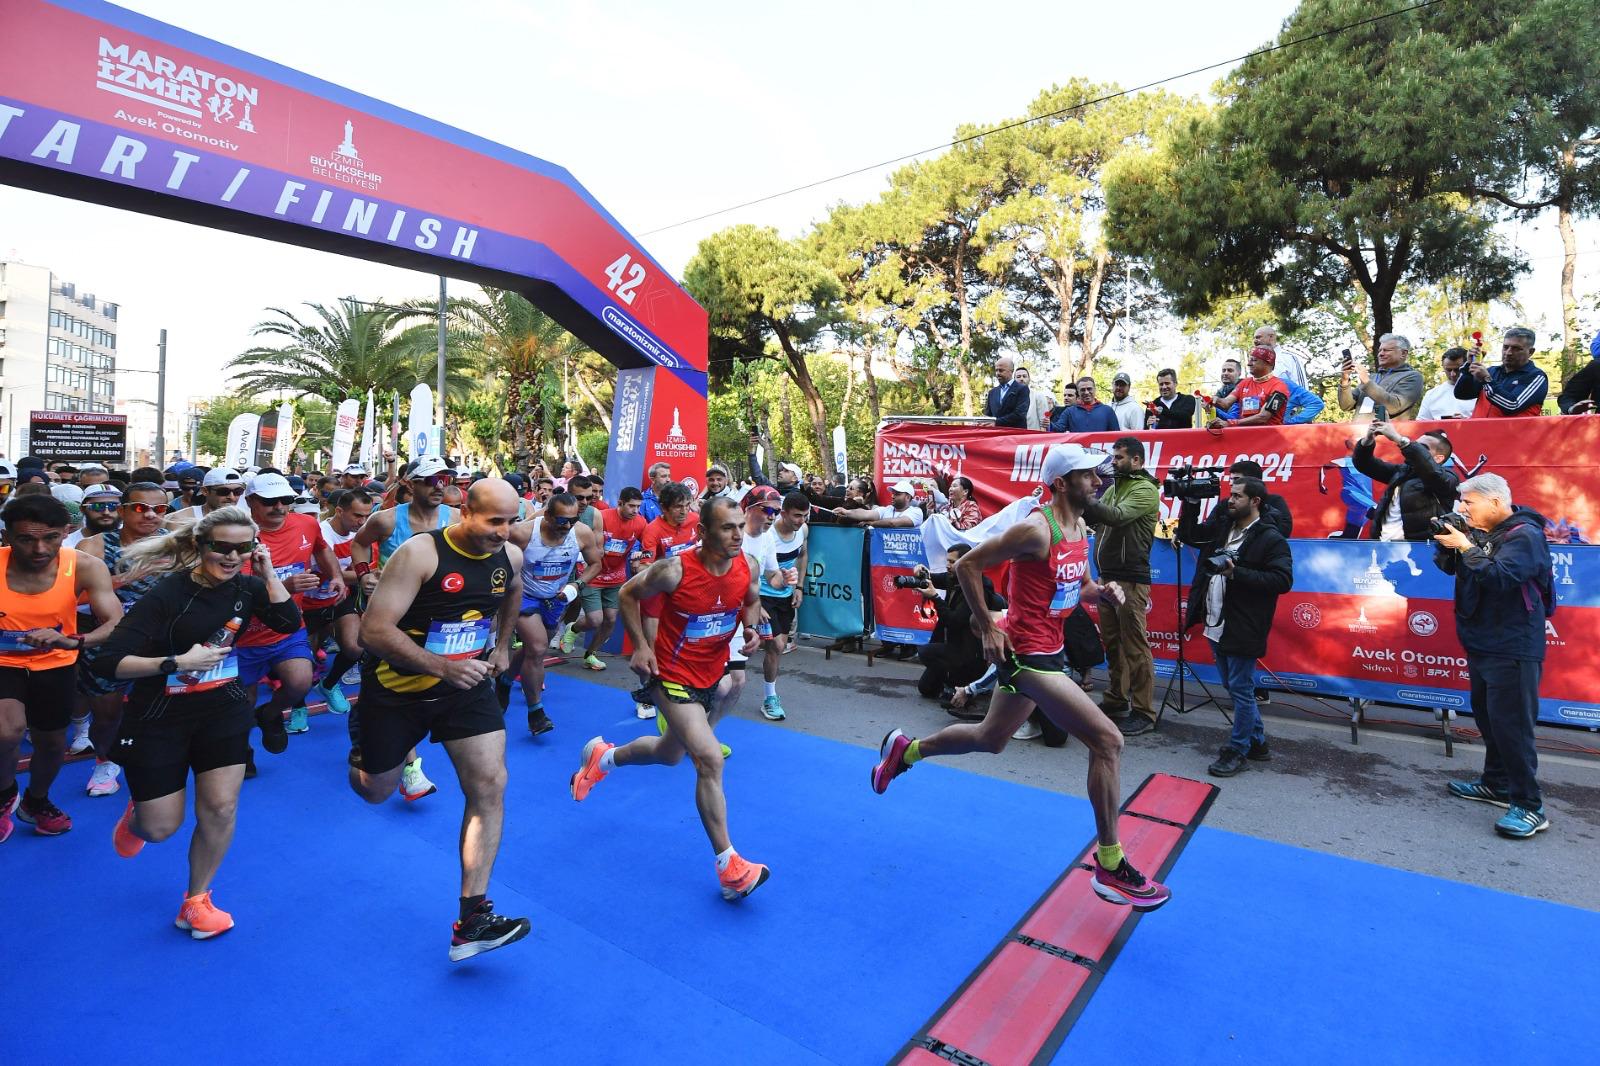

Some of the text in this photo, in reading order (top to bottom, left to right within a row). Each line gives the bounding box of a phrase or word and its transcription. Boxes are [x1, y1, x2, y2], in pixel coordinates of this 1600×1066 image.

[99, 36, 258, 106] MARATON
[114, 109, 239, 151] Avek Otomotiv
[157, 111, 202, 129] Powered by
[274, 180, 479, 260] FINISH
[607, 311, 675, 368] maratonizmir.org
[616, 375, 632, 452] MARATON
[240, 429, 250, 454] Avek
[883, 442, 967, 460] MARATON
[883, 458, 934, 475] İZMİR
[1165, 453, 1295, 482] 2104.24
[883, 533, 923, 542] MARATON
[704, 621, 722, 636] 26
[444, 631, 477, 653] 1149
[1352, 646, 1396, 661] Avek
[1426, 668, 1451, 678] SPX
[1401, 690, 1460, 704] maratonizmir.org
